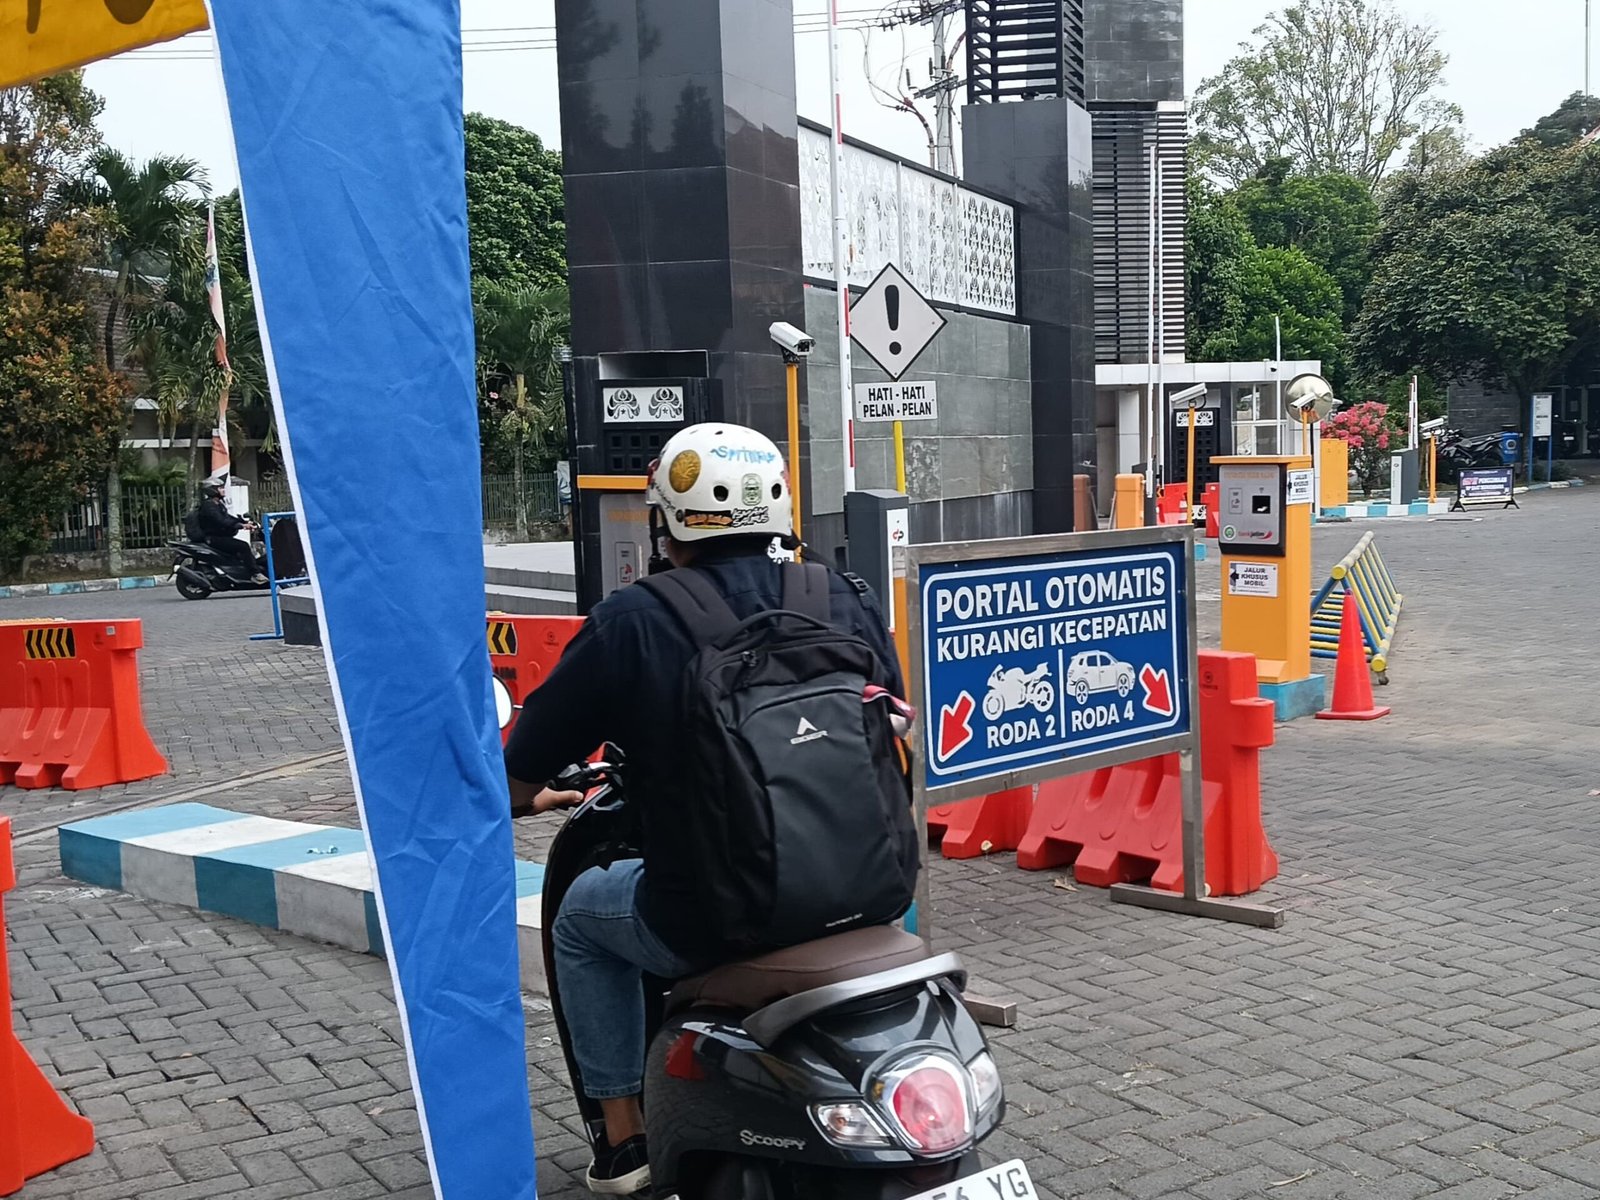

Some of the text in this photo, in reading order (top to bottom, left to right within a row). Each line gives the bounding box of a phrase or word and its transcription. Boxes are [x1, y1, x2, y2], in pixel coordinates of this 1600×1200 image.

[863, 403, 894, 418] PELAN
[902, 402, 932, 416] PELAN
[868, 387, 893, 401] HATI
[902, 386, 925, 400] HATI
[936, 566, 1165, 622] PORTAL OTOMATIS
[937, 609, 1166, 662] KURANGI KECEPATAN
[987, 714, 1056, 748] RODA 2
[1071, 700, 1135, 732] RODA 4
